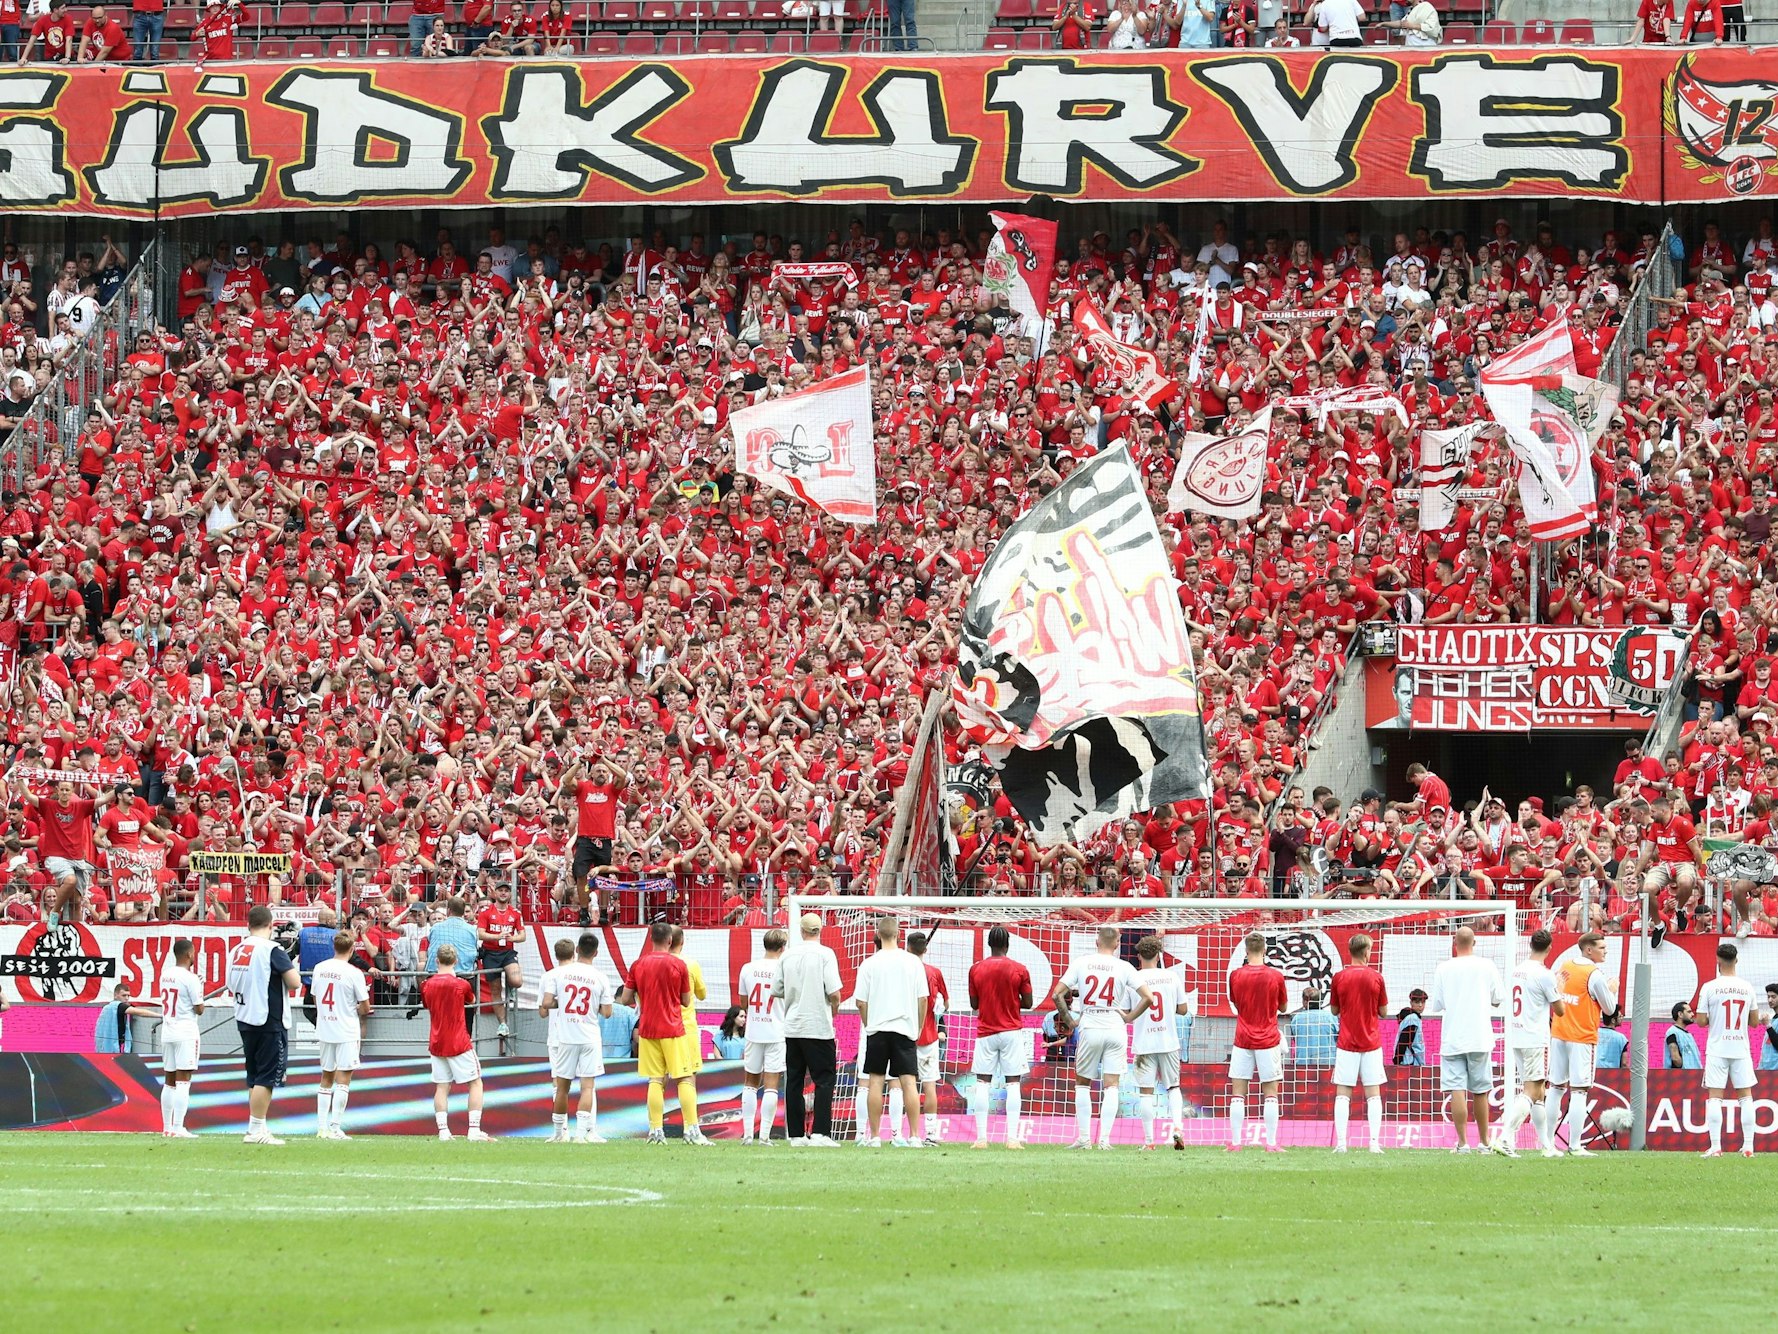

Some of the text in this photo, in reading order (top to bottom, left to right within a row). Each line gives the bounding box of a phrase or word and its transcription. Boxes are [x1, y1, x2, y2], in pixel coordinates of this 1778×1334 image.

[208, 29, 227, 39] REWE
[1721, 98, 1775, 146] 12
[686, 264, 705, 272] REWE
[72, 307, 82, 323] 9
[804, 309, 823, 317] REWE
[1261, 309, 1337, 319] DOUBLESIEGER
[580, 476, 597, 484] REW
[1397, 627, 1538, 664] CHAOTIX
[1539, 633, 1613, 668] SPS
[1539, 675, 1610, 707] CGN
[1412, 700, 1532, 731] JUNGS
[36, 768, 109, 784] SYNDIKAT
[1656, 836, 1677, 846] REWE
[1502, 883, 1525, 892] REWE
[489, 924, 513, 932] REWE
[57, 959, 109, 975] 2007
[1087, 964, 1114, 972] CHABOT
[319, 972, 342, 981] HÜBERS
[564, 974, 596, 985] ADAMYAN
[321, 982, 335, 1012] 4
[748, 983, 774, 1014] 47
[1083, 974, 1115, 1007] 24
[161, 988, 178, 1018] 37
[564, 983, 591, 1016] 23
[1148, 991, 1164, 1022] 9
[1512, 985, 1522, 1018] 6
[1721, 999, 1746, 1031] 17
